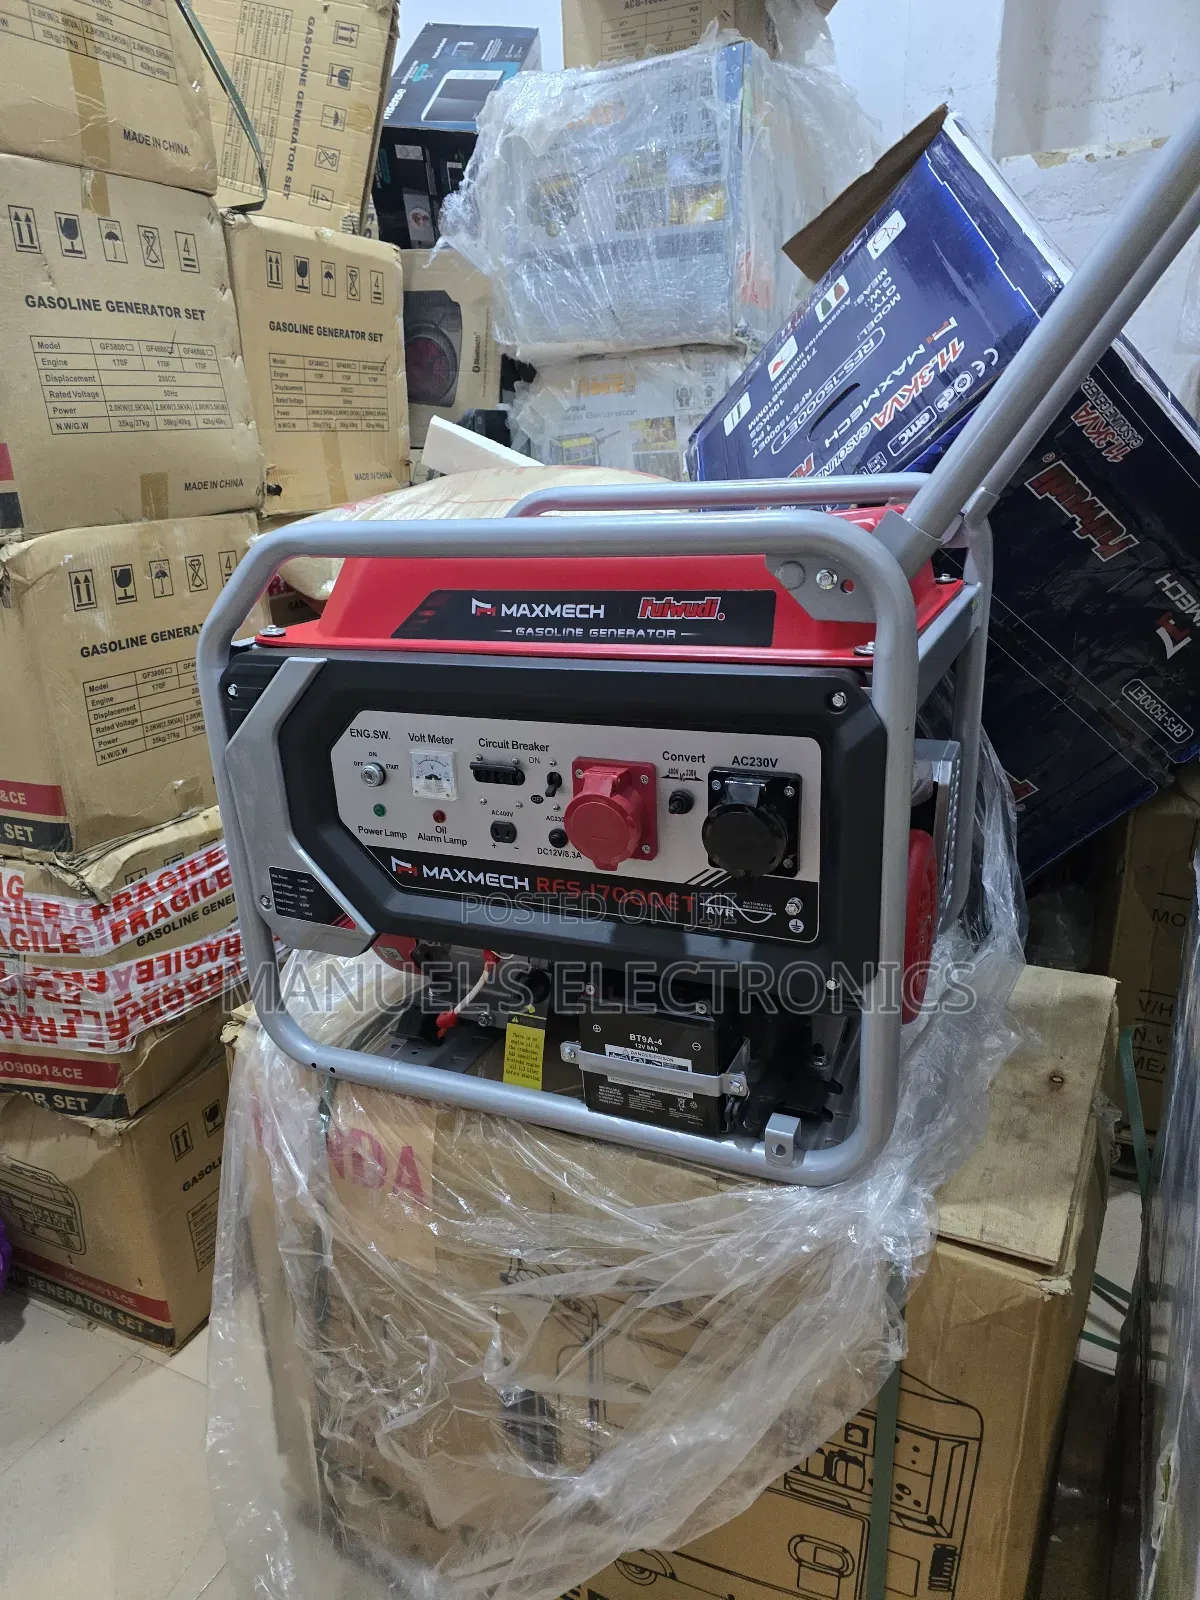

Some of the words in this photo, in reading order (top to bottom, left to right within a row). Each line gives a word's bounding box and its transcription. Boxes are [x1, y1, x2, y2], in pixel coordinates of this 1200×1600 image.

[299, 16, 315, 87] GASOLINE
[287, 91, 304, 172] GENERATOR
[122, 128, 151, 147] MADE
[152, 137, 161, 148] IN
[162, 139, 190, 156] CHINA
[283, 175, 293, 200] SET
[854, 268, 888, 307] MEAS:
[871, 285, 896, 313] QTY:
[25, 295, 102, 312] GASOLINE
[106, 300, 181, 318] GENERATOR
[184, 308, 206, 321] SET
[856, 293, 901, 340] MODEL:
[269, 321, 314, 336] GASOLINE
[316, 326, 366, 341] GENERATOR
[368, 332, 383, 342] SET
[37, 341, 61, 350] Model
[42, 358, 68, 367] Engine
[112, 358, 128, 366] 170F
[45, 374, 96, 384] Displacement
[871, 337, 965, 431] 11.3KVA
[49, 390, 71, 399] Rated
[72, 391, 100, 400] Voltage
[781, 338, 875, 445] RFS-15000ET
[825, 344, 925, 448] MAXMECH
[56, 422, 89, 430] N.W/G.W
[118, 420, 150, 428] 35kg/37kg
[750, 400, 784, 439] 100KGS
[1070, 400, 1130, 462] 11.3KVA
[376, 472, 392, 480] CHINA
[184, 481, 208, 491] MADE
[210, 480, 218, 490] IN
[219, 478, 244, 488] CHINA
[501, 604, 605, 618] MAXMECH
[516, 627, 584, 638] GASOLINE
[589, 628, 676, 639] GENERATOR
[80, 635, 148, 658] GASOLINE
[89, 682, 108, 692] Model
[91, 696, 114, 707] Engine
[152, 682, 166, 691] 170F
[94, 704, 136, 720] Displacement
[1128, 685, 1188, 739] RFS-15000ET
[96, 724, 113, 735] Rated
[114, 717, 138, 730] Voltage
[350, 728, 391, 740] ENG.SW.
[98, 737, 118, 748] Power
[408, 732, 426, 743] Volt
[428, 734, 454, 744] Meter
[478, 738, 510, 750] Circuit
[512, 740, 550, 752] Breaker
[100, 748, 128, 762] N.W/G.W
[662, 751, 706, 764] Convert
[732, 756, 778, 768] AC230V
[492, 810, 514, 818] AC400V
[4, 823, 34, 843] SET
[358, 826, 383, 836] Power
[384, 829, 408, 839] Lamp
[436, 826, 447, 834] Oil
[418, 833, 442, 842] Alarm
[444, 836, 468, 846] Lamp
[538, 848, 582, 859] DC12V/8.3A
[422, 865, 530, 892] MAXMECH
[109, 865, 233, 946] FRAGILE
[706, 907, 734, 918] AVR
[136, 912, 200, 947] GASOLINE
[630, 1034, 662, 1046] BT9A-4
[53, 1095, 88, 1112] SET
[28, 1276, 116, 1321] GENERATOR
[117, 1314, 144, 1333] SET
